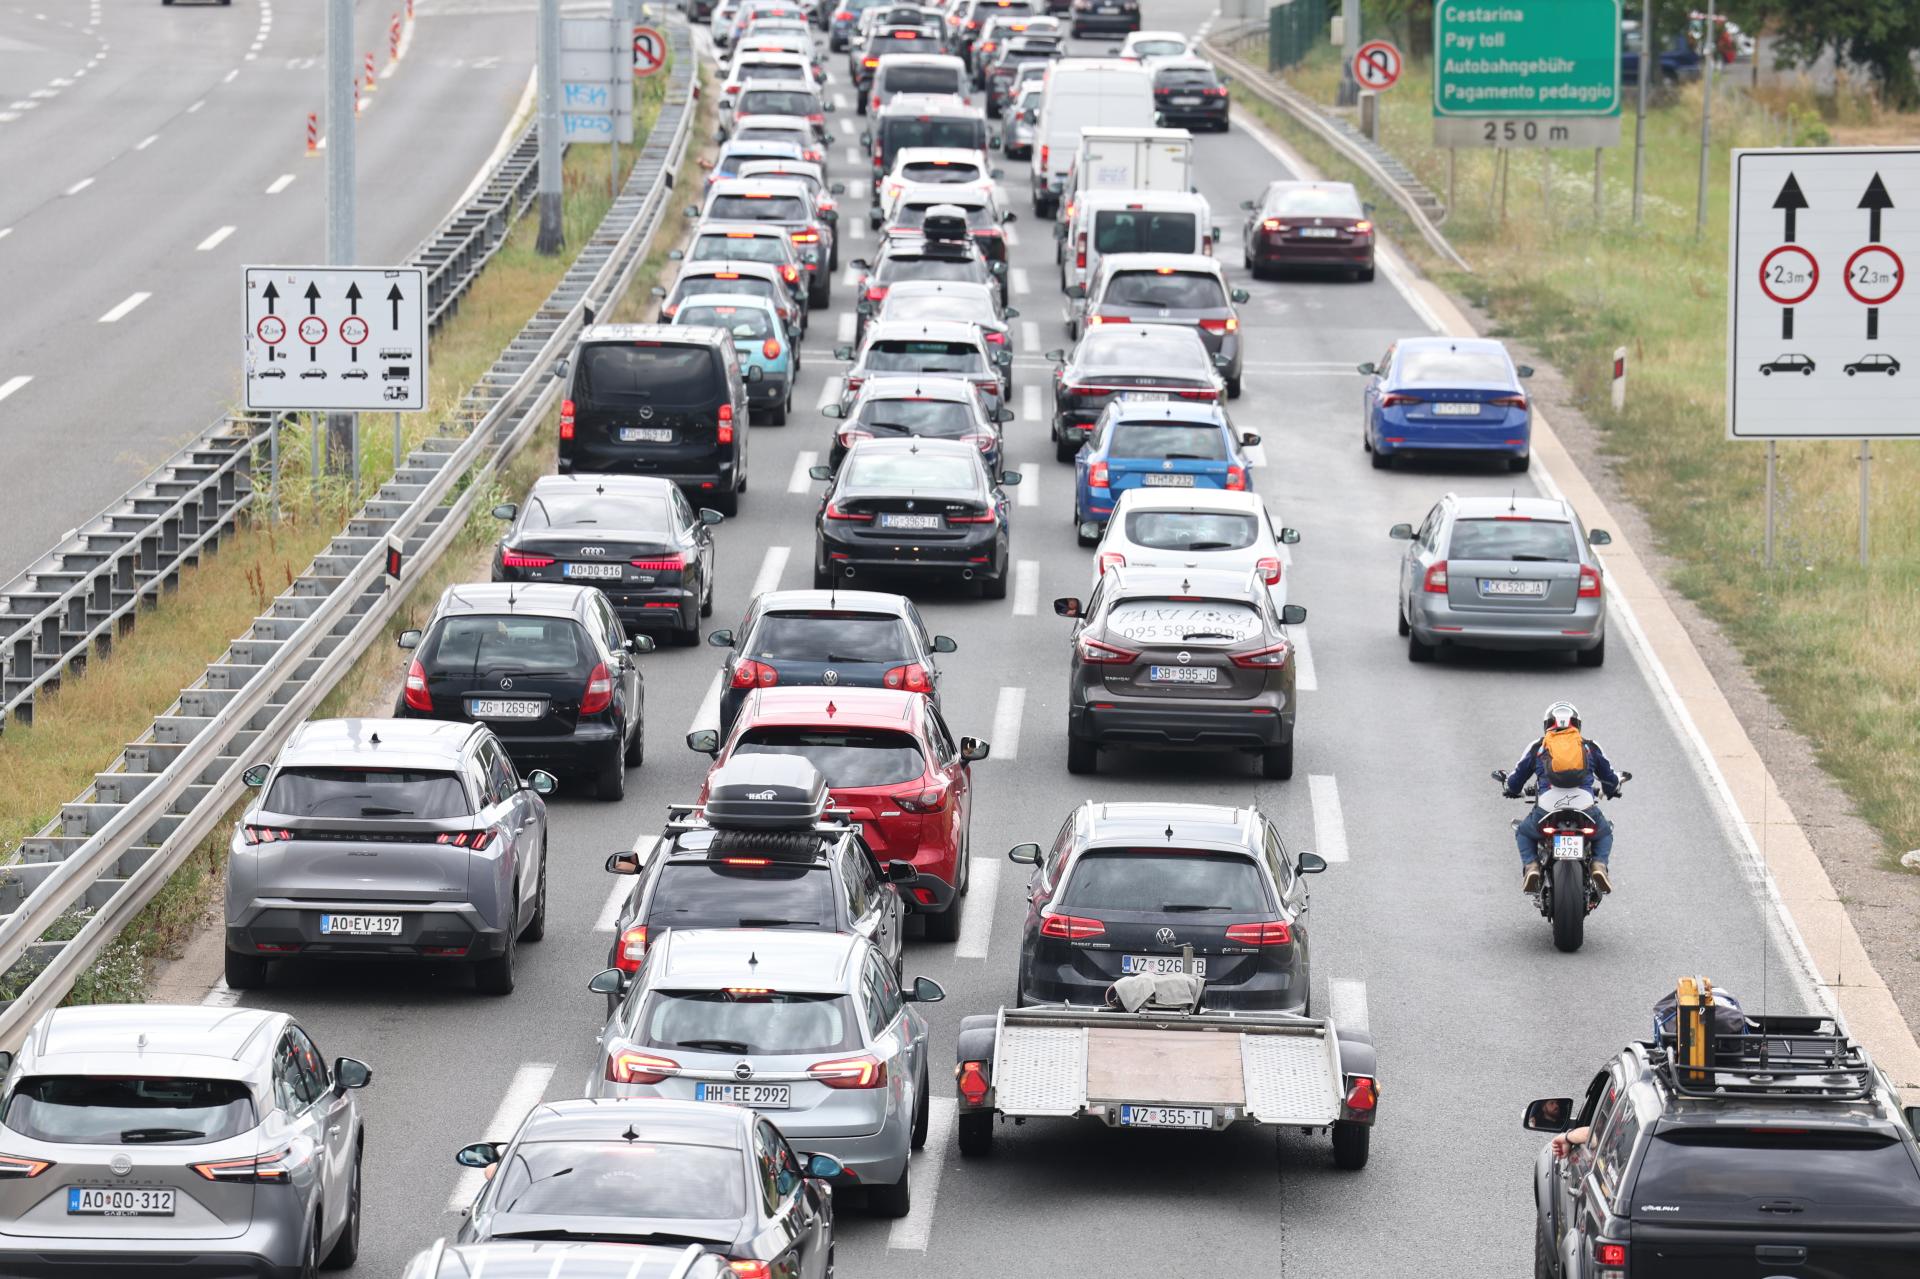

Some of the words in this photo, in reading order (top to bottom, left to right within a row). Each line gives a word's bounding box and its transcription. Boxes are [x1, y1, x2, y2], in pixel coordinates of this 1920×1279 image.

[1445, 8, 1523, 22] Cestarina
[1445, 33, 1474, 50] Pay
[1480, 33, 1504, 47] toll
[1444, 58, 1576, 77] Autobahngebühr
[1444, 84, 1535, 102] Pagamento
[1539, 83, 1612, 102] pedaggio
[1484, 121, 1537, 141] 250
[1550, 126, 1568, 140] m
[331, 917, 348, 931] AO
[354, 917, 400, 931] EV-197
[1132, 958, 1147, 971] VZ
[705, 1085, 723, 1101] HH
[733, 1086, 751, 1102] EE
[754, 1087, 788, 1103] 2992
[1132, 1108, 1149, 1123] VZ
[1160, 1109, 1209, 1125] 355-TL
[82, 1191, 104, 1208] AO
[113, 1192, 171, 1209] QO-312
